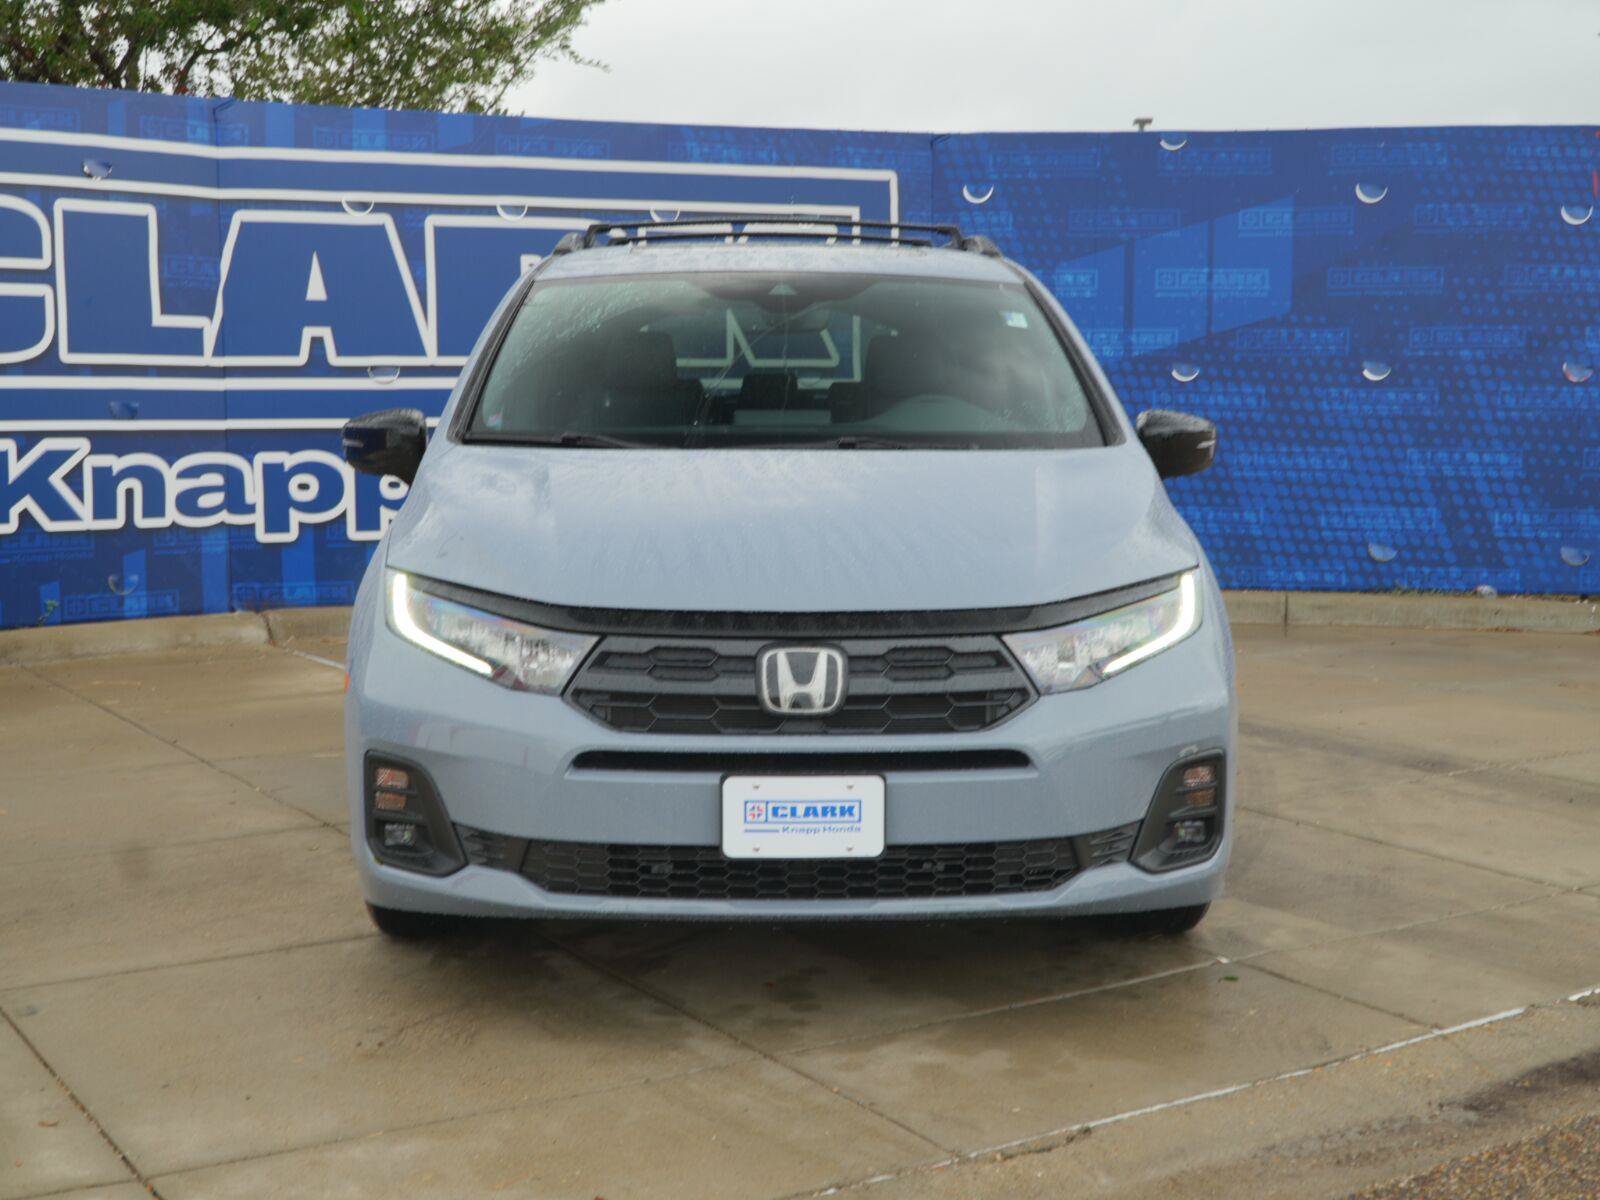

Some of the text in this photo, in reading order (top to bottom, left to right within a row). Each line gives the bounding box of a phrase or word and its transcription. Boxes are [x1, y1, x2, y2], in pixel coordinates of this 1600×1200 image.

[771, 805, 856, 818] CLARK
[781, 825, 862, 836] Knapp Honda
